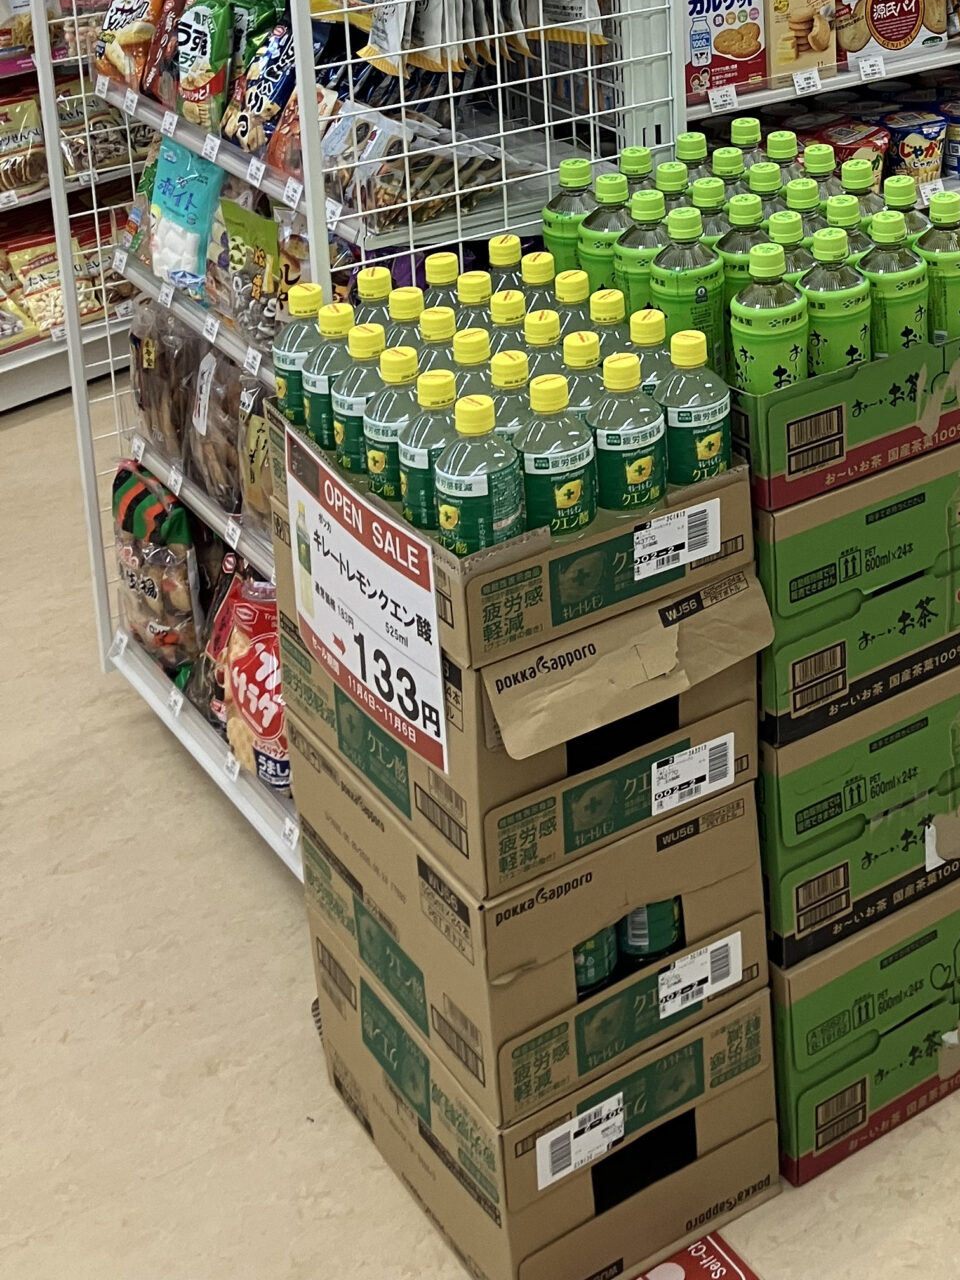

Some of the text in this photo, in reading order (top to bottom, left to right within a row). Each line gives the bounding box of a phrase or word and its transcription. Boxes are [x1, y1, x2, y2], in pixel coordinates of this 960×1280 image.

[621, 485, 660, 506] クエン酸
[324, 479, 420, 576] OPEN SALE
[551, 512, 589, 531] クエン酸
[313, 530, 433, 647] キレートレモンクエン酸
[483, 585, 543, 623] 疲労感
[385, 622, 409, 648] 525ml
[483, 612, 524, 642] 軽減
[354, 631, 442, 739] 133円
[499, 816, 558, 854] 疲労感
[499, 845, 538, 873] 軽減
